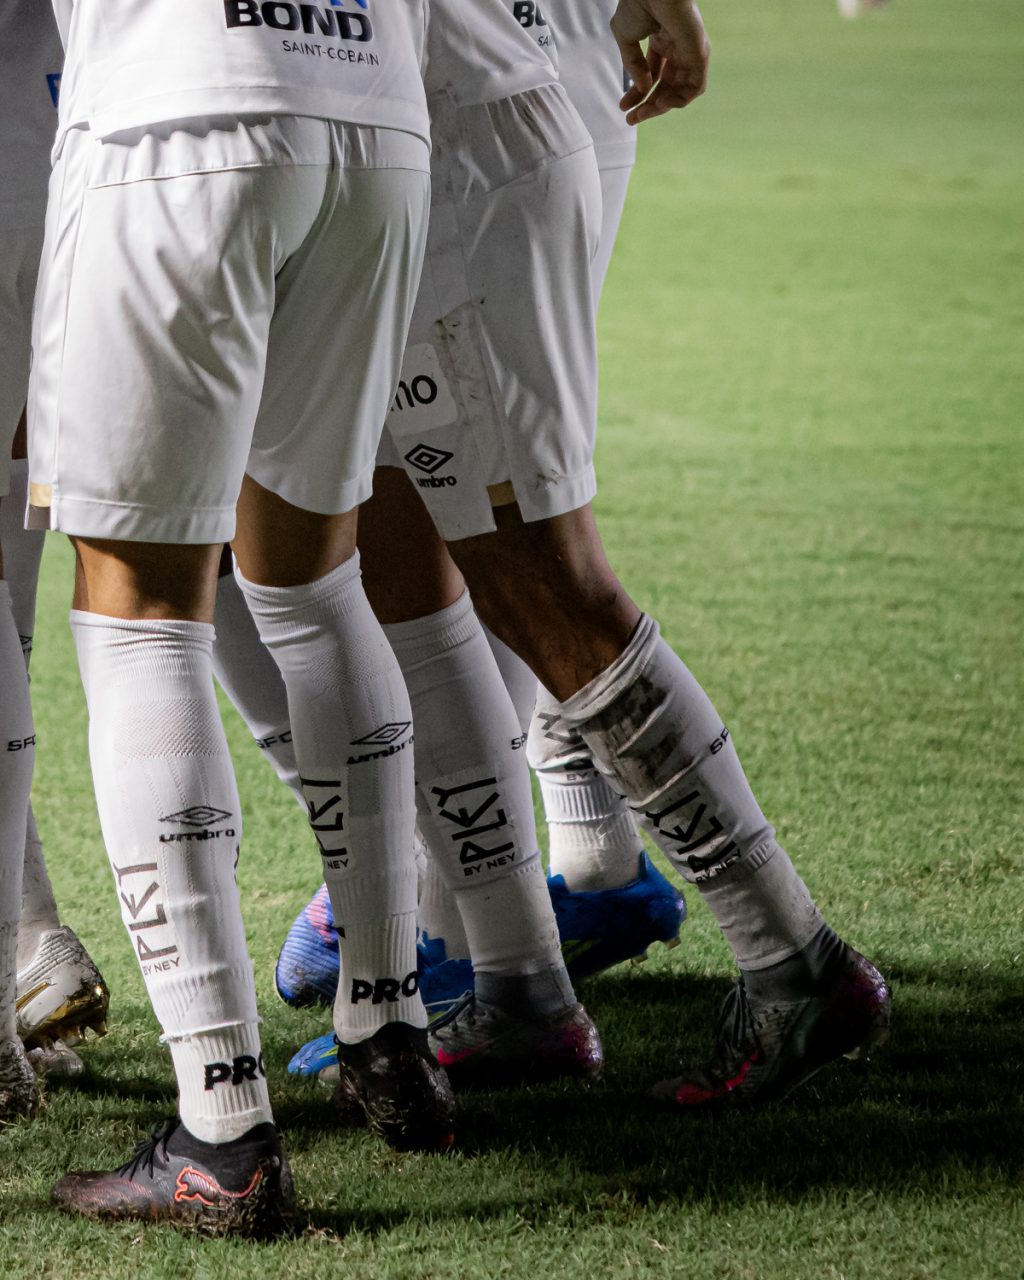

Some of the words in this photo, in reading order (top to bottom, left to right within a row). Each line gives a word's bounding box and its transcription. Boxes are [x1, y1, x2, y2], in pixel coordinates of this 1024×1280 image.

[416, 475, 457, 488] umbro
[159, 828, 236, 843] umbro
[464, 863, 482, 877] BY
[486, 852, 516, 869] NEY
[154, 957, 181, 971] NEY
[351, 971, 419, 1004] PRO
